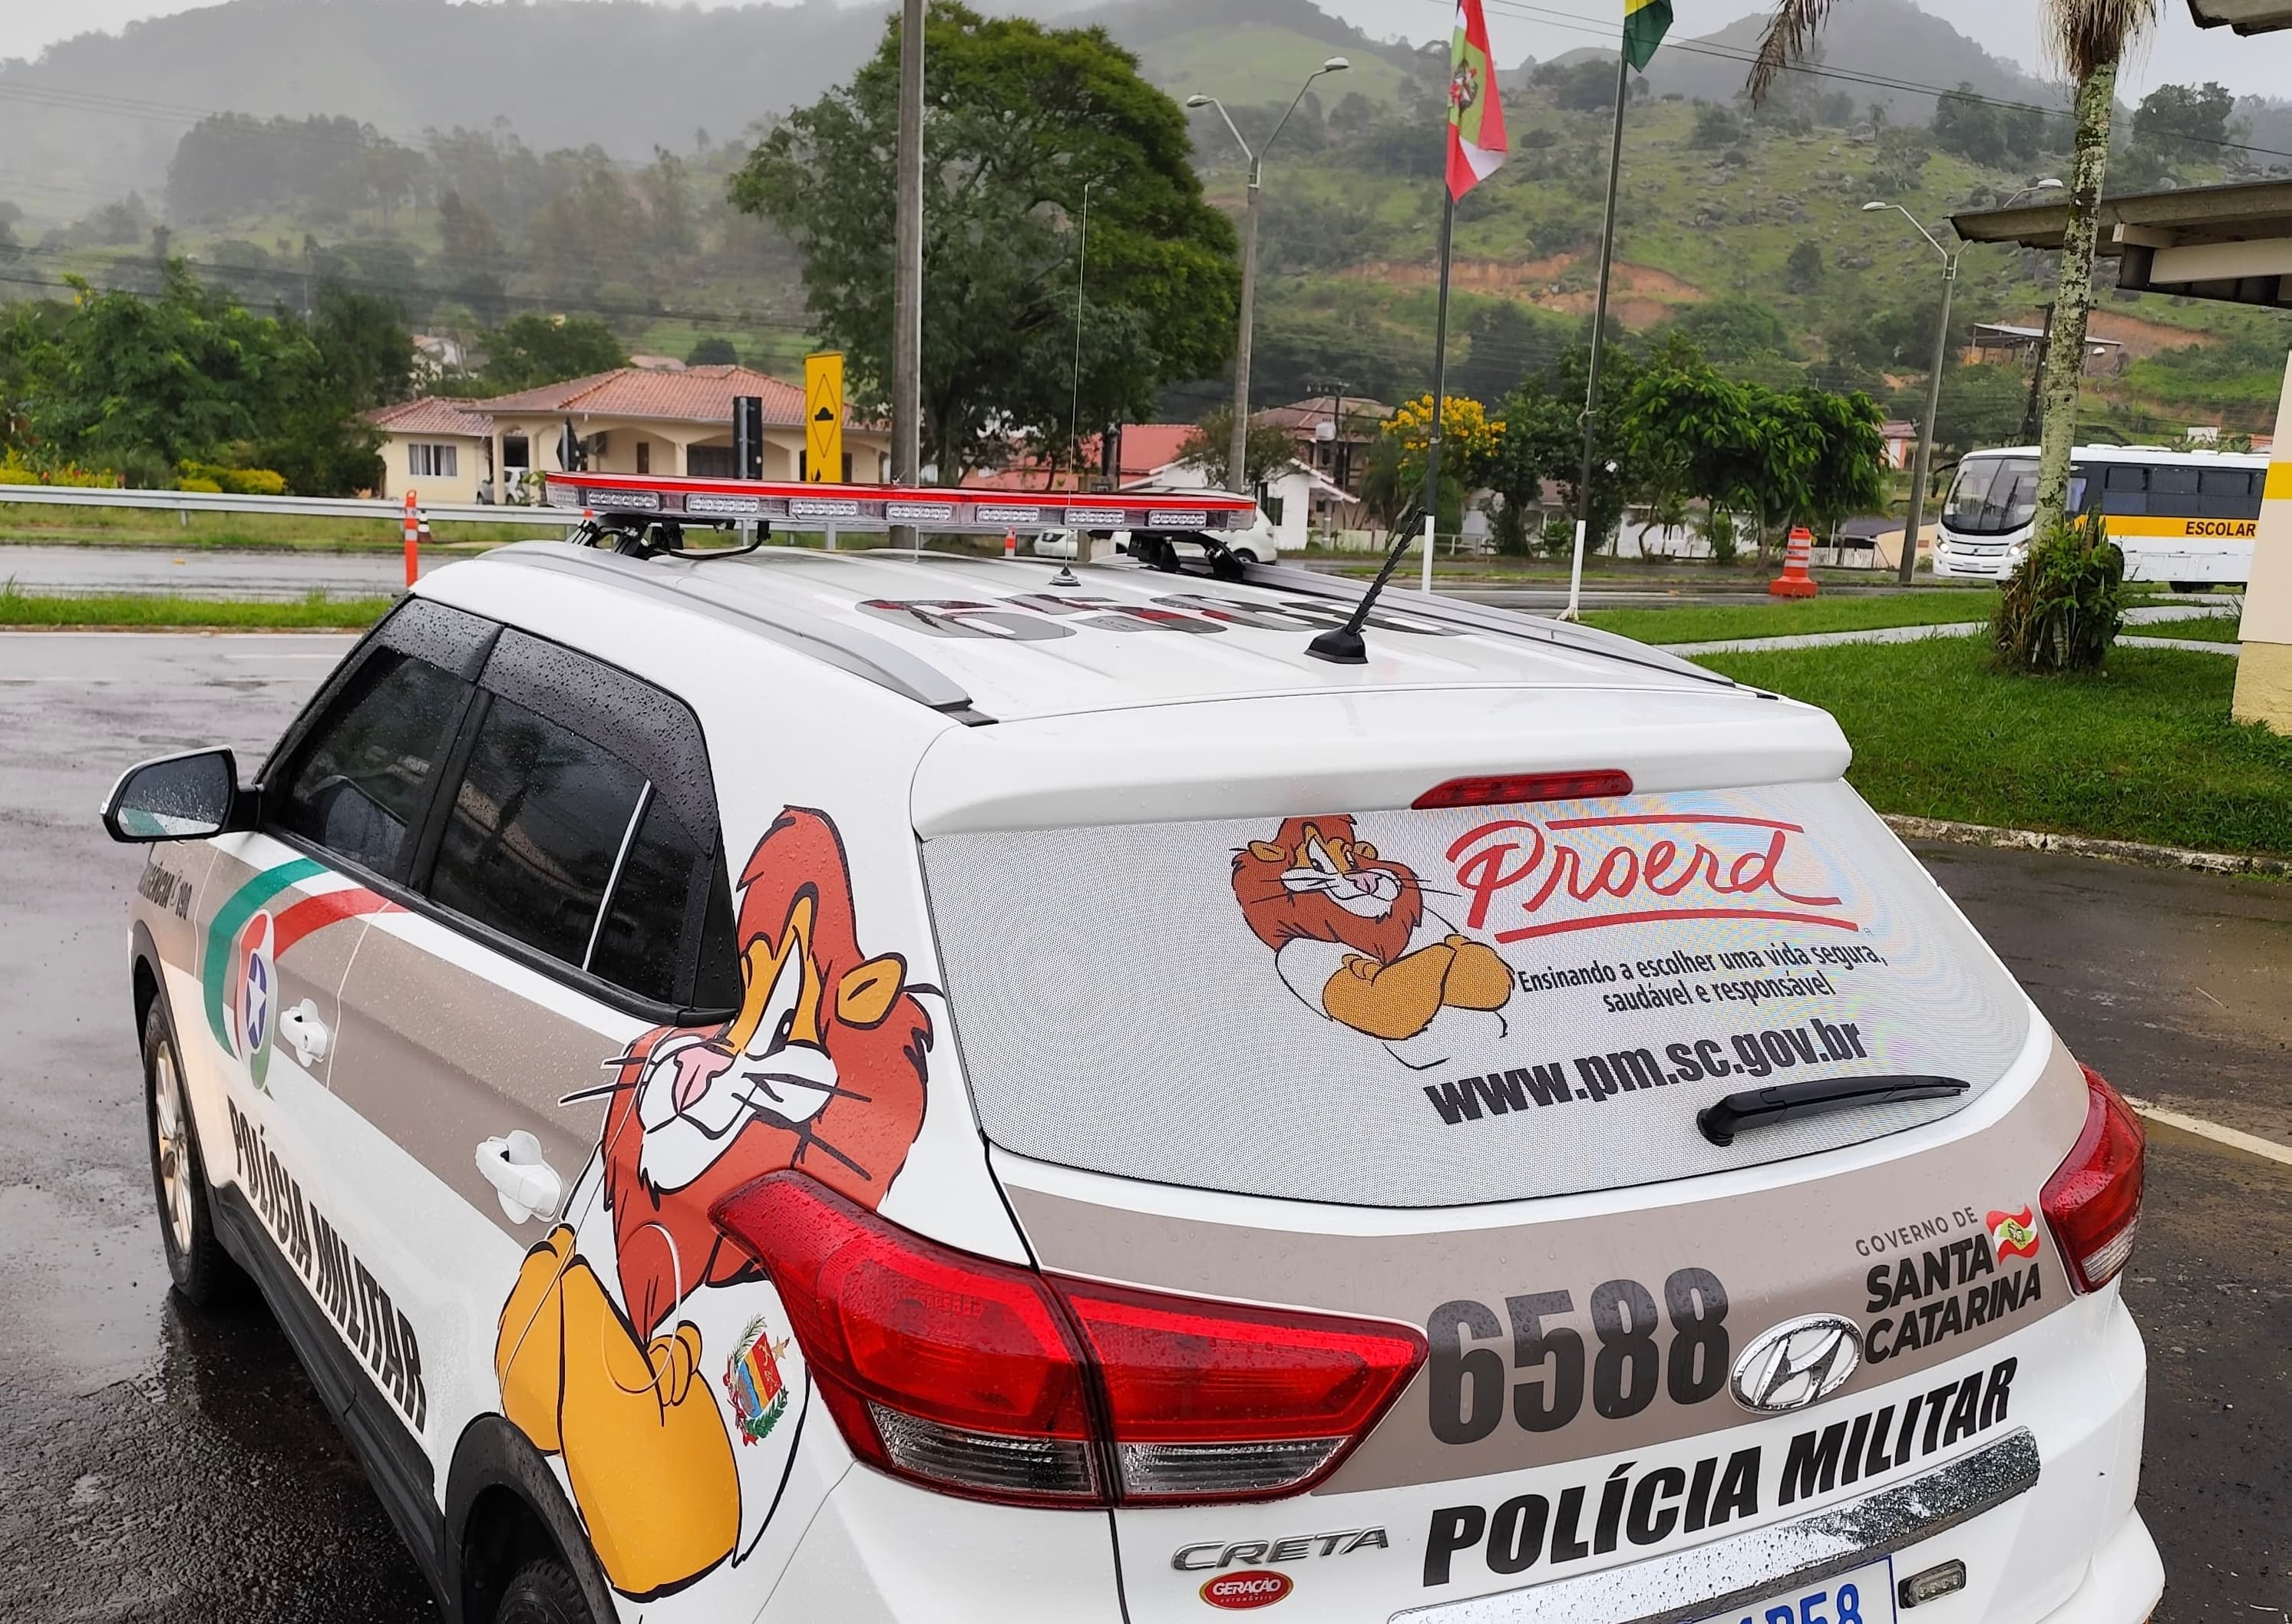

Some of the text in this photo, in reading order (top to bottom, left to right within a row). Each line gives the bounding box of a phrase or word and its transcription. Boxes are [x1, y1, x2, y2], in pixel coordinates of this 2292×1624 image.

[2185, 521, 2256, 537] ESCOLAR
[1445, 819, 1842, 929] Proerd
[1519, 942, 1888, 993] Ensinando a escolher uma vida segura,
[1603, 969, 1838, 1013] saudável e responsável
[1424, 1018, 1868, 1125] www.pm.sc.gov.br
[227, 1094, 427, 1434] POLÍCIA MILITAR
[1855, 1206, 1979, 1256] GOVERNO DE
[1866, 1233, 1994, 1313] SANTA
[1864, 1263, 2042, 1365] CATARINA
[1426, 1268, 1731, 1445] 6588
[1423, 1355, 2019, 1588] POLÍCIA MILITAR
[1171, 1525, 1389, 1571] CRETA
[1212, 1577, 1282, 1596] GERAÇÃO
